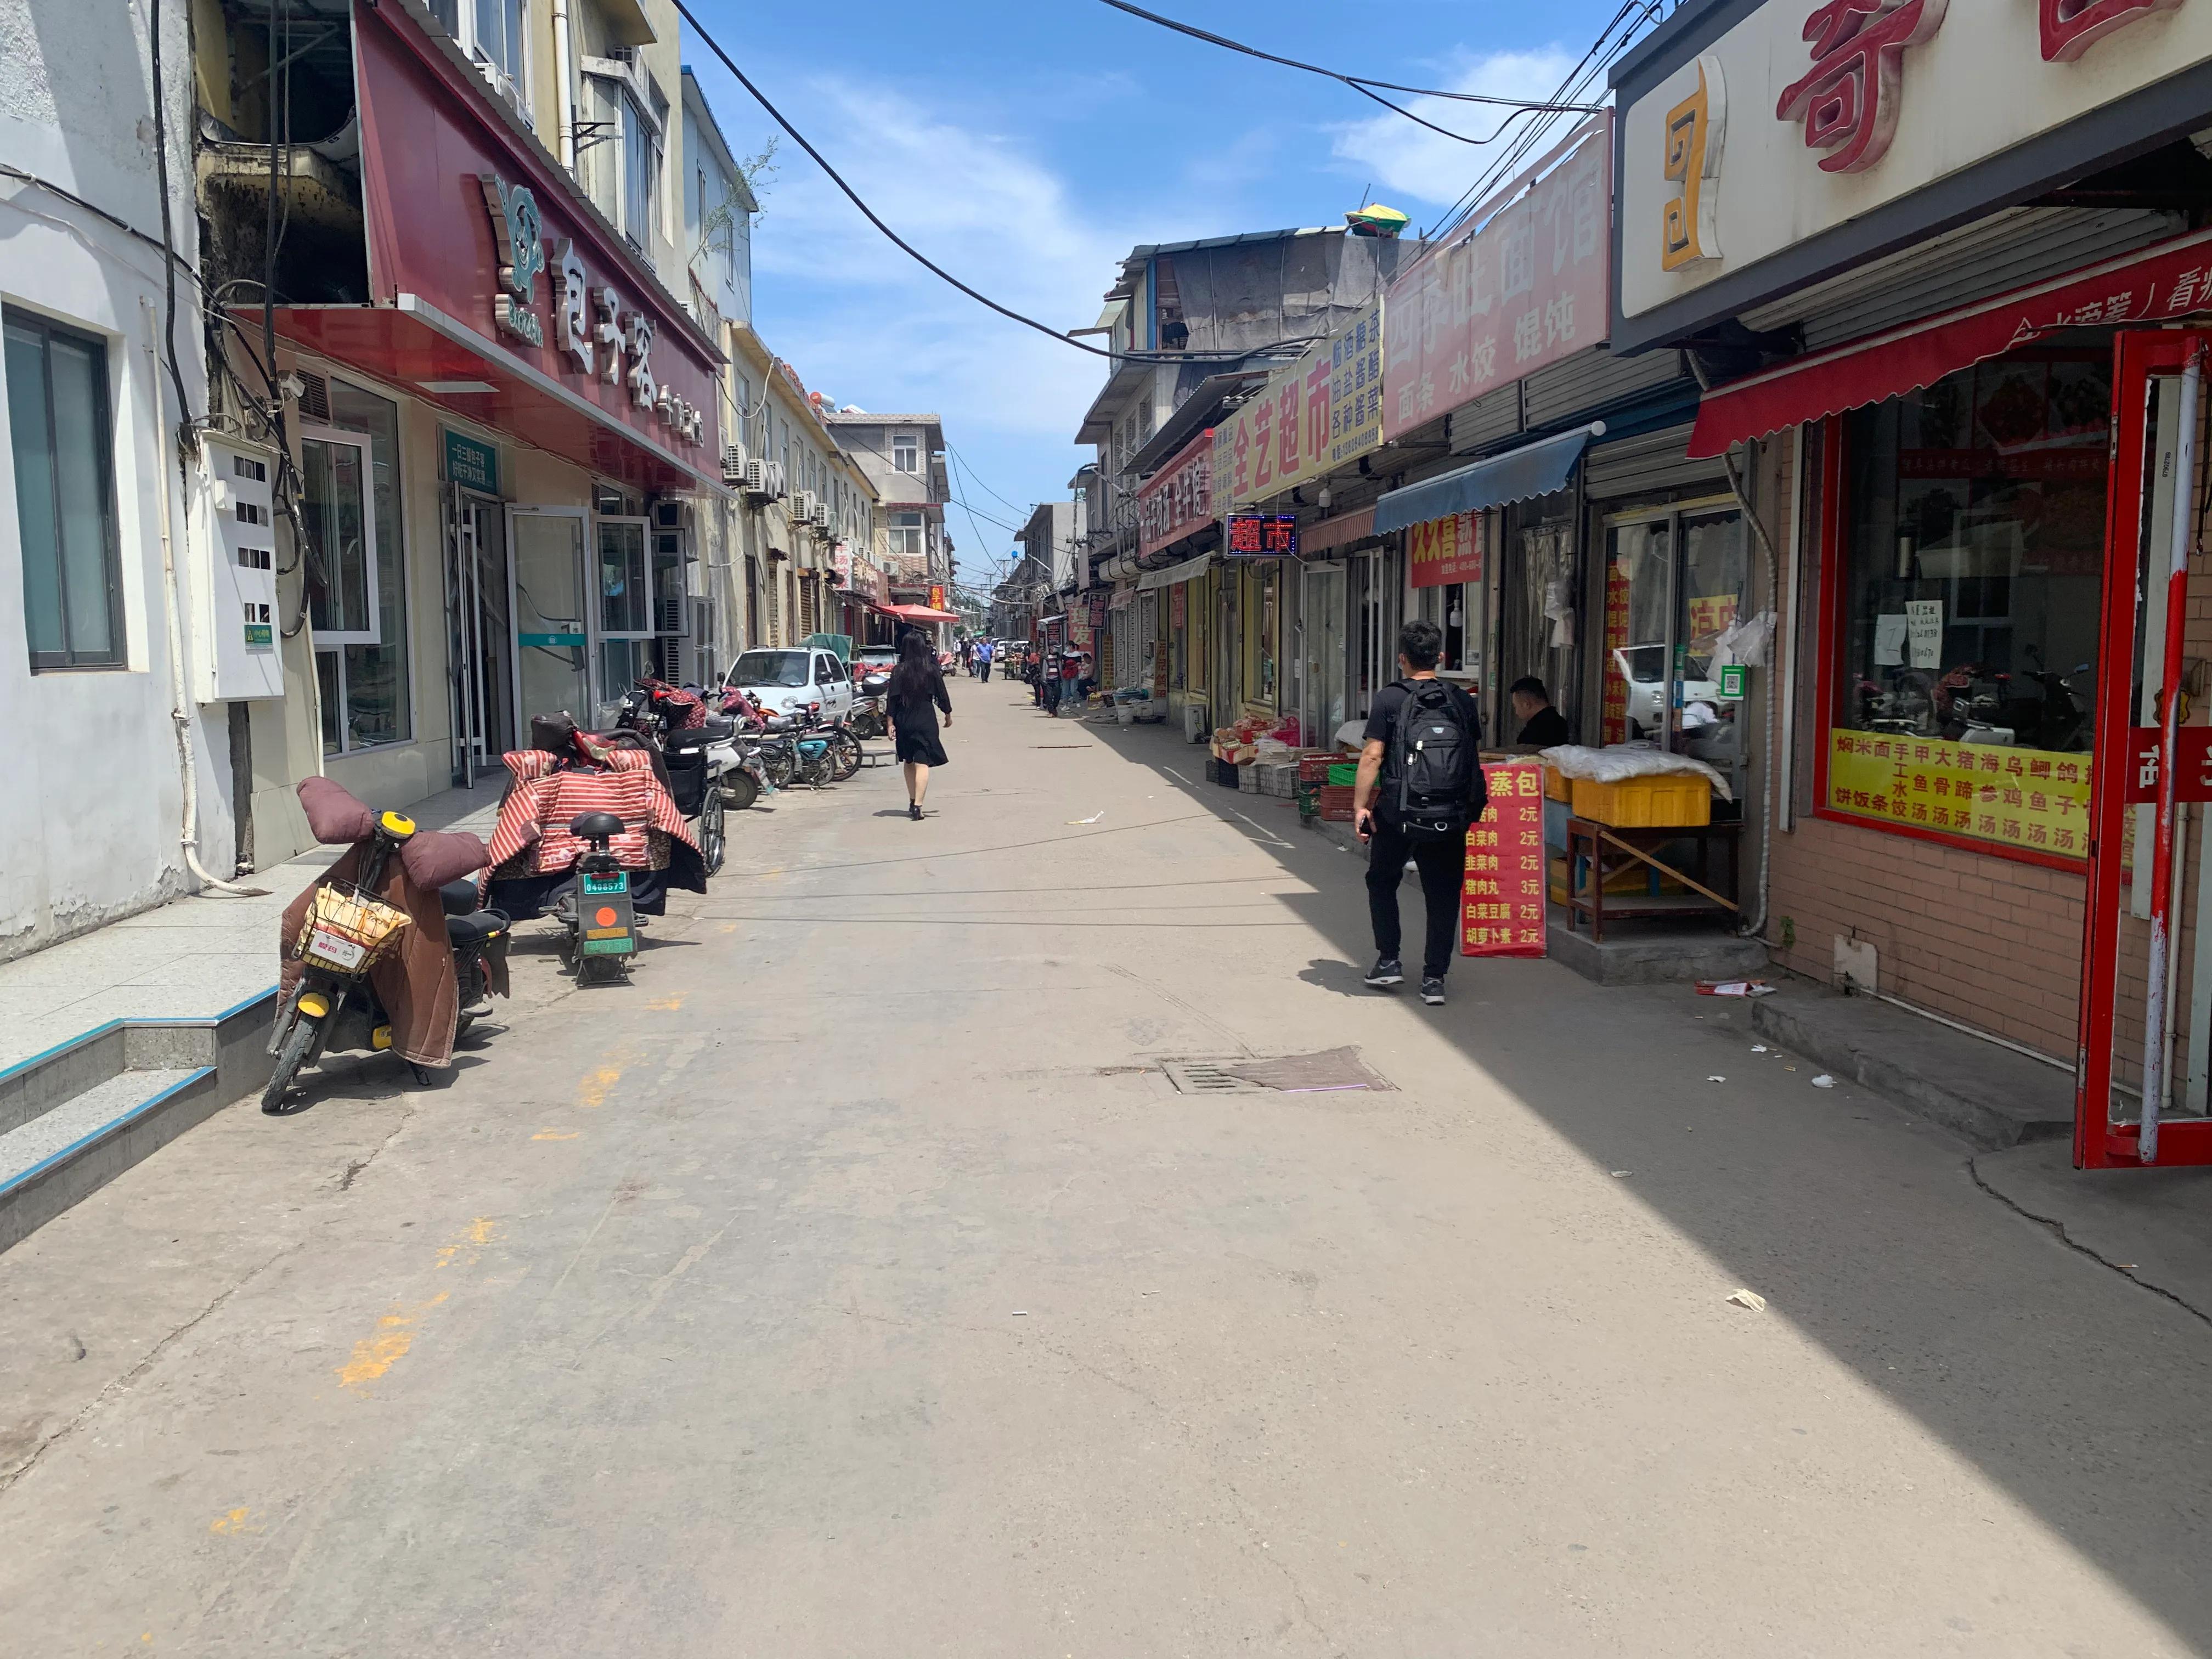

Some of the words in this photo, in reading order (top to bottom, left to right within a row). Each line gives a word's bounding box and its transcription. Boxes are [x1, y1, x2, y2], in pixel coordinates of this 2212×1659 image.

[561, 238, 658, 411] 包子客
[1333, 308, 1380, 371] 烟酒糖茶
[1398, 371, 1435, 424] 面条
[1449, 335, 1496, 394] 水饺
[1514, 291, 1576, 363] 馄饨
[1333, 348, 1379, 405] 油盐酱醋
[1233, 354, 1331, 498] 全艺超市
[1333, 385, 1379, 439] 各种酱菜
[1229, 518, 1294, 551] 超市
[1071, 607, 1091, 645] 理发
[1489, 771, 1539, 797] 蒸包
[1835, 736, 1853, 805] 焖饼
[1853, 738, 1871, 806] 米饭
[1871, 740, 1890, 812] 面条
[1892, 743, 1909, 817] 手工水饺
[1912, 744, 1929, 821] 甲鱼汤
[1933, 747, 1951, 825] 大骨汤
[1954, 750, 1974, 830] 猪蹄汤
[1978, 753, 1999, 834] 海参汤
[2003, 755, 2023, 839] 乌鸡汤
[2027, 758, 2050, 844] 鲫鱼汤
[1465, 830, 1498, 847] 白菜肉
[1519, 830, 1538, 846] 2元
[1519, 806, 1538, 822] 2元
[2053, 761, 2078, 850] 鸽子汤
[586, 882, 624, 891] 0408573
[1465, 854, 1498, 871] 韭菜肉
[1520, 854, 1539, 870] 2元
[1465, 878, 1499, 895] 猪肉丸
[1521, 879, 1539, 895] 3元
[1466, 902, 1510, 919] 白菜豆腐
[1520, 904, 1539, 919] 2元
[1466, 927, 1512, 944] 胡萝卜素
[1520, 929, 1539, 943] 2元
